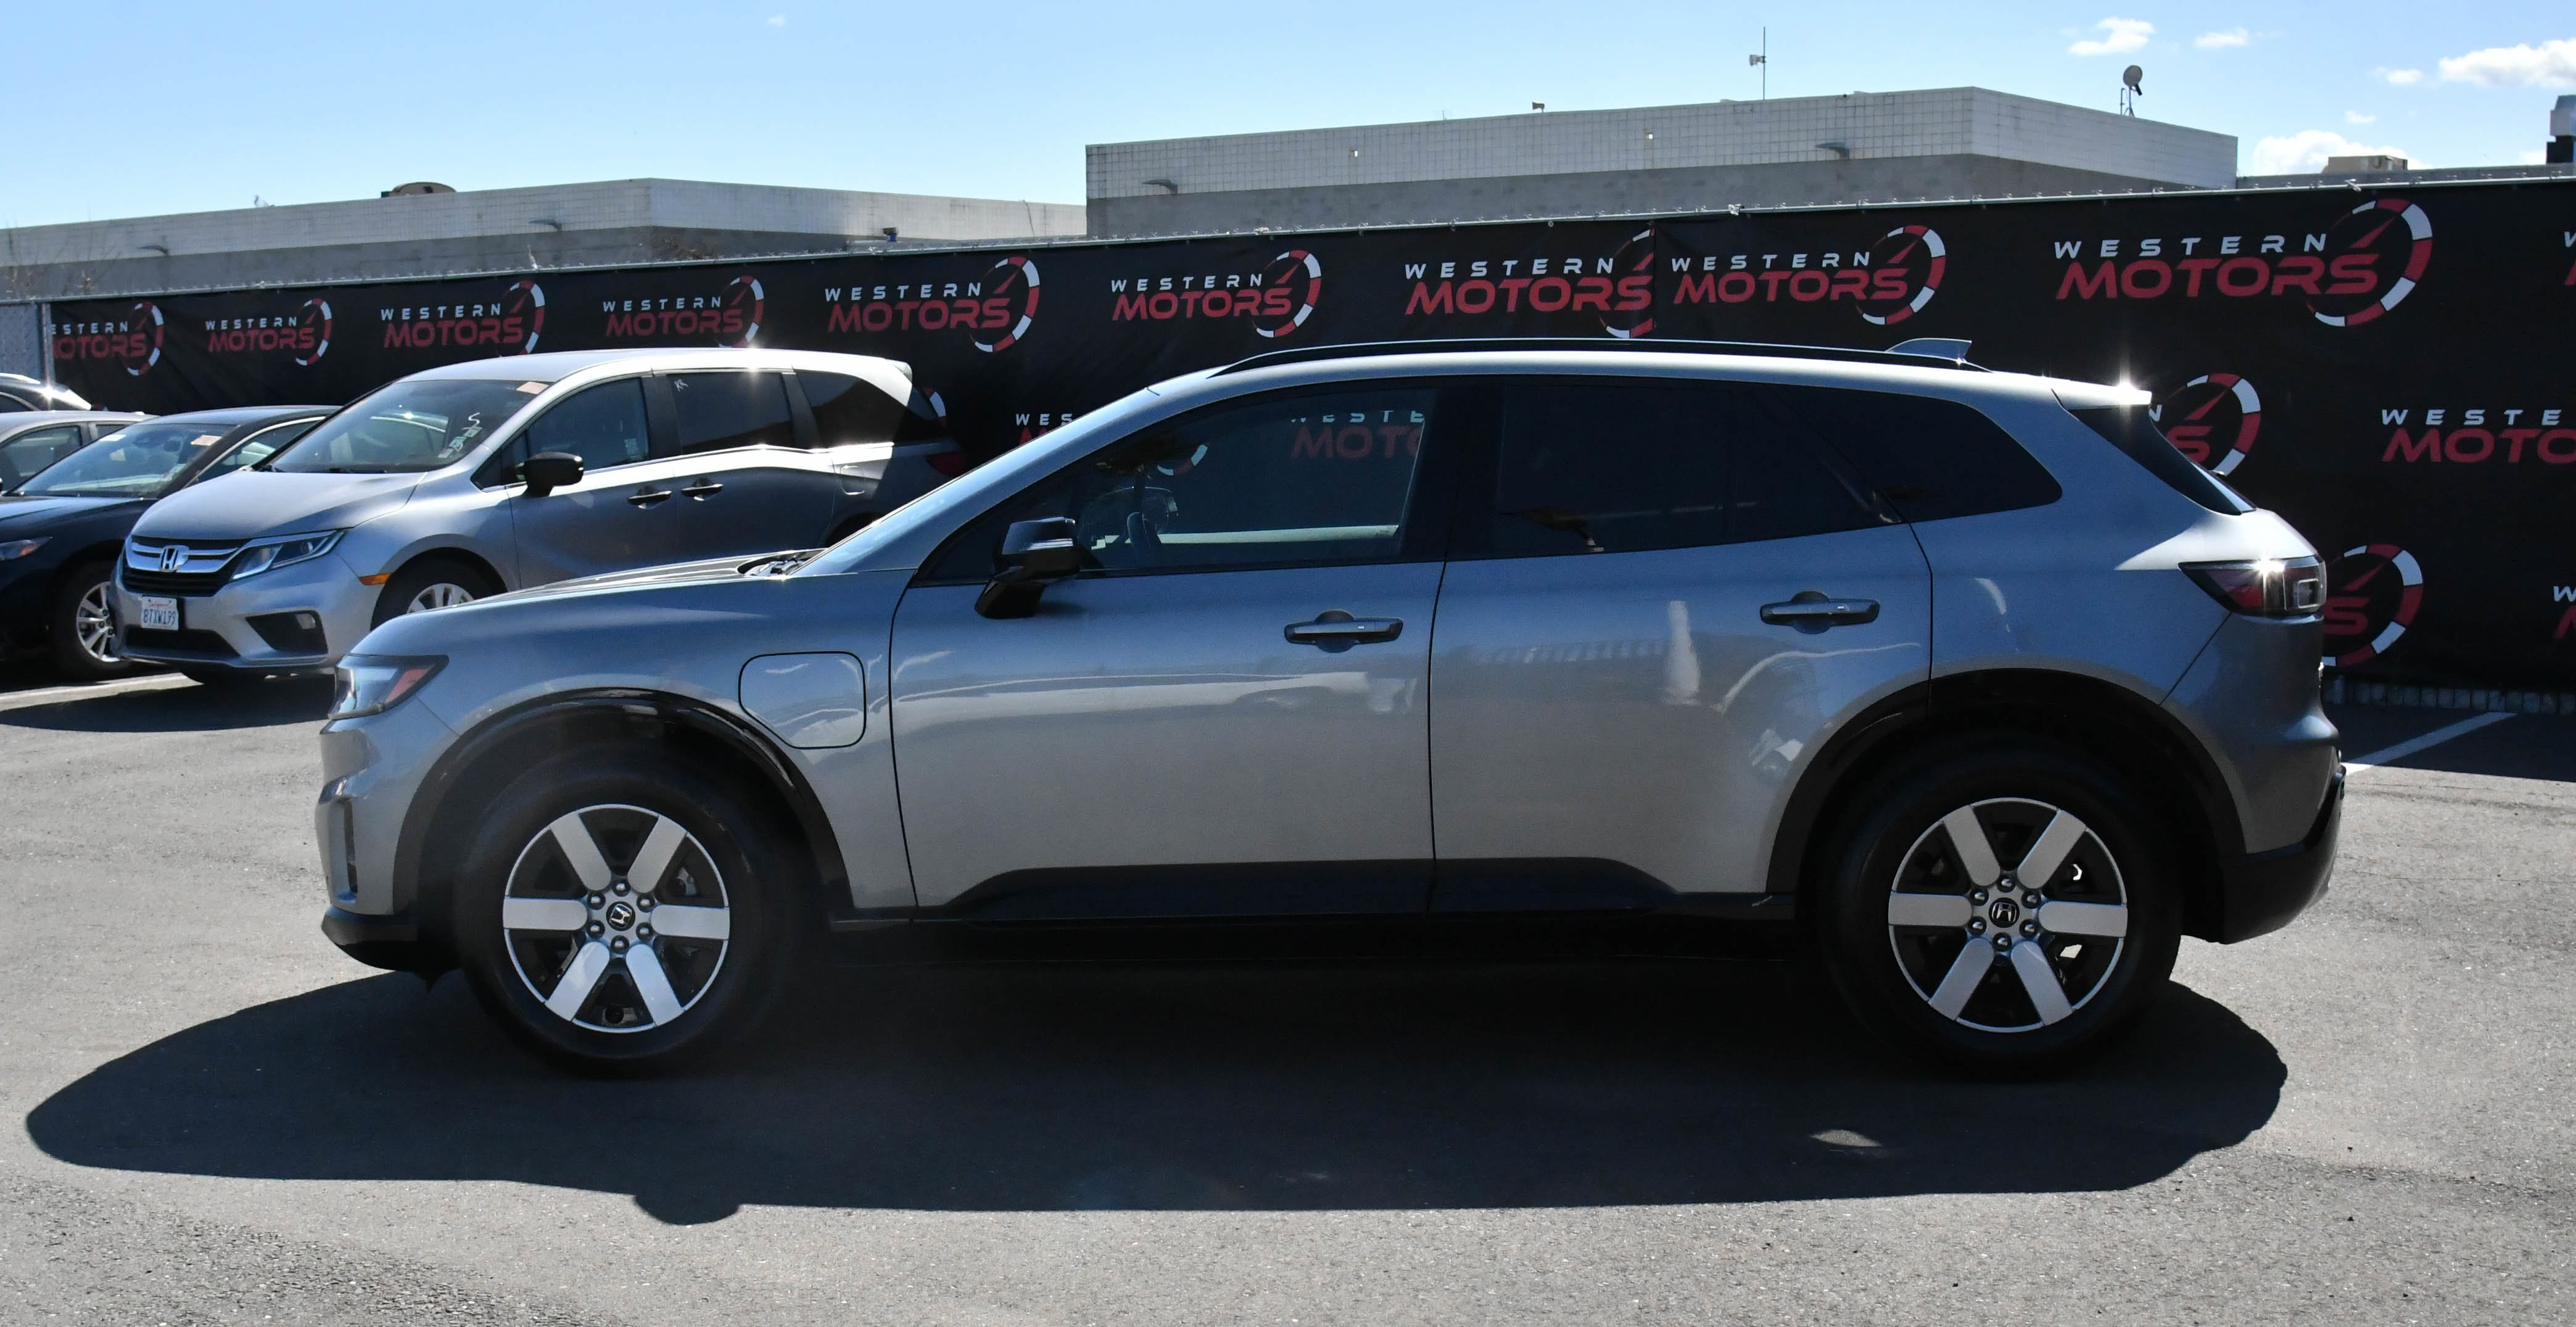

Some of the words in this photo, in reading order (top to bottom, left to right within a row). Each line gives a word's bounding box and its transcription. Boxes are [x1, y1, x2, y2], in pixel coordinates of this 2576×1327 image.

[2054, 233, 2326, 259] WESTERN
[1405, 257, 1614, 279] WESTERN
[1671, 251, 1870, 272] WESTERN
[1111, 273, 1262, 292] WESTERN
[1674, 268, 1910, 305] MOTORS
[2056, 254, 2380, 300] MOTORS
[603, 296, 721, 312] WESTERN
[825, 282, 981, 302] WESTERN
[1112, 287, 1294, 321] MOTORS
[1405, 275, 1653, 315] MOTORS
[205, 316, 297, 331] WESTERN
[381, 303, 501, 321] WESTERN
[606, 308, 744, 337] MOTORS
[828, 297, 1011, 333] MOTORS
[51, 321, 128, 335] ESTERN
[208, 326, 315, 353] MOTORS
[384, 316, 526, 349] MOTORS
[53, 333, 147, 360] OTORS
[2381, 409, 2562, 426] WESTE
[1292, 424, 1422, 460] MOT
[2381, 428, 2576, 463] MOTO
